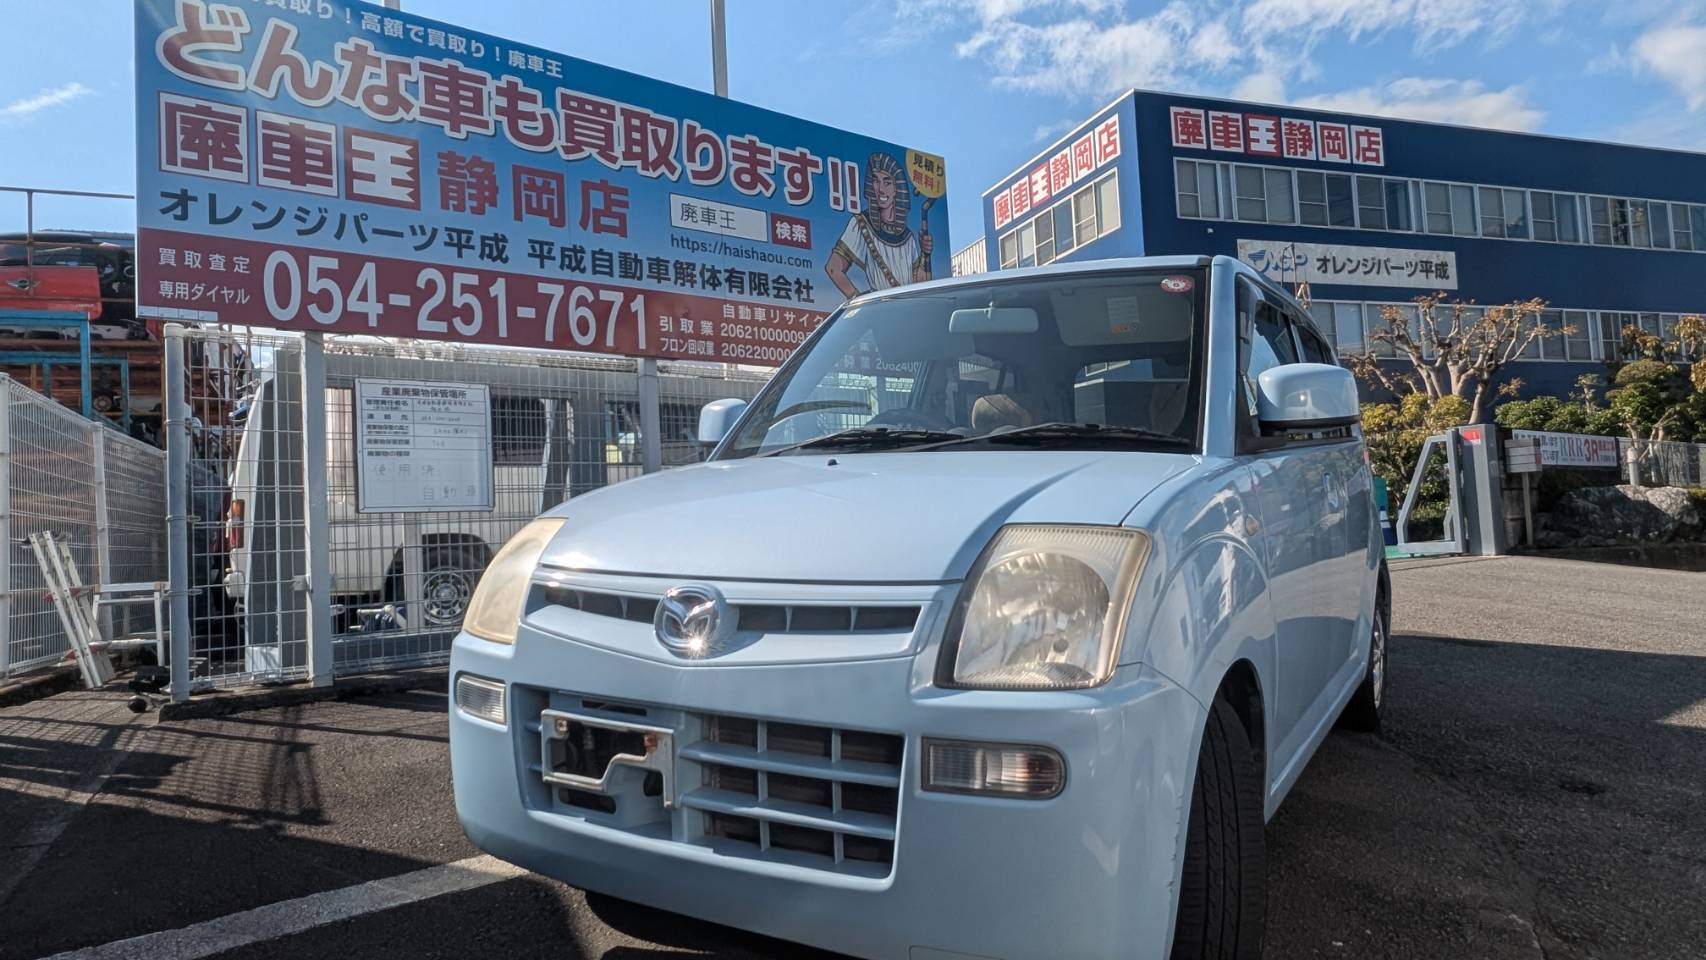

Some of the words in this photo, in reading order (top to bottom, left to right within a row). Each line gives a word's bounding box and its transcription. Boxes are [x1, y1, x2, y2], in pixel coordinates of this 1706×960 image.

[156, 0, 861, 213] どんな車も買取ります!!
[1170, 106, 1384, 167] 廃車王静岡店
[994, 114, 1120, 230] 廃車王静岡店
[680, 203, 737, 231] 廃車王
[775, 220, 808, 244] 検索
[159, 189, 510, 264] オレンジパーツ平成
[528, 238, 815, 304] 平成自動車解体有限会社
[671, 234, 813, 269] https://haishaou.com
[159, 248, 250, 274] 買取査定
[1316, 256, 1450, 281] オレンジパーツ平成
[159, 280, 250, 305] 専用ダイヤル
[263, 249, 648, 350] 054-251-7671
[659, 316, 714, 336] 引取業
[660, 337, 715, 356] フロン回収業
[721, 343, 795, 361] 206220000
